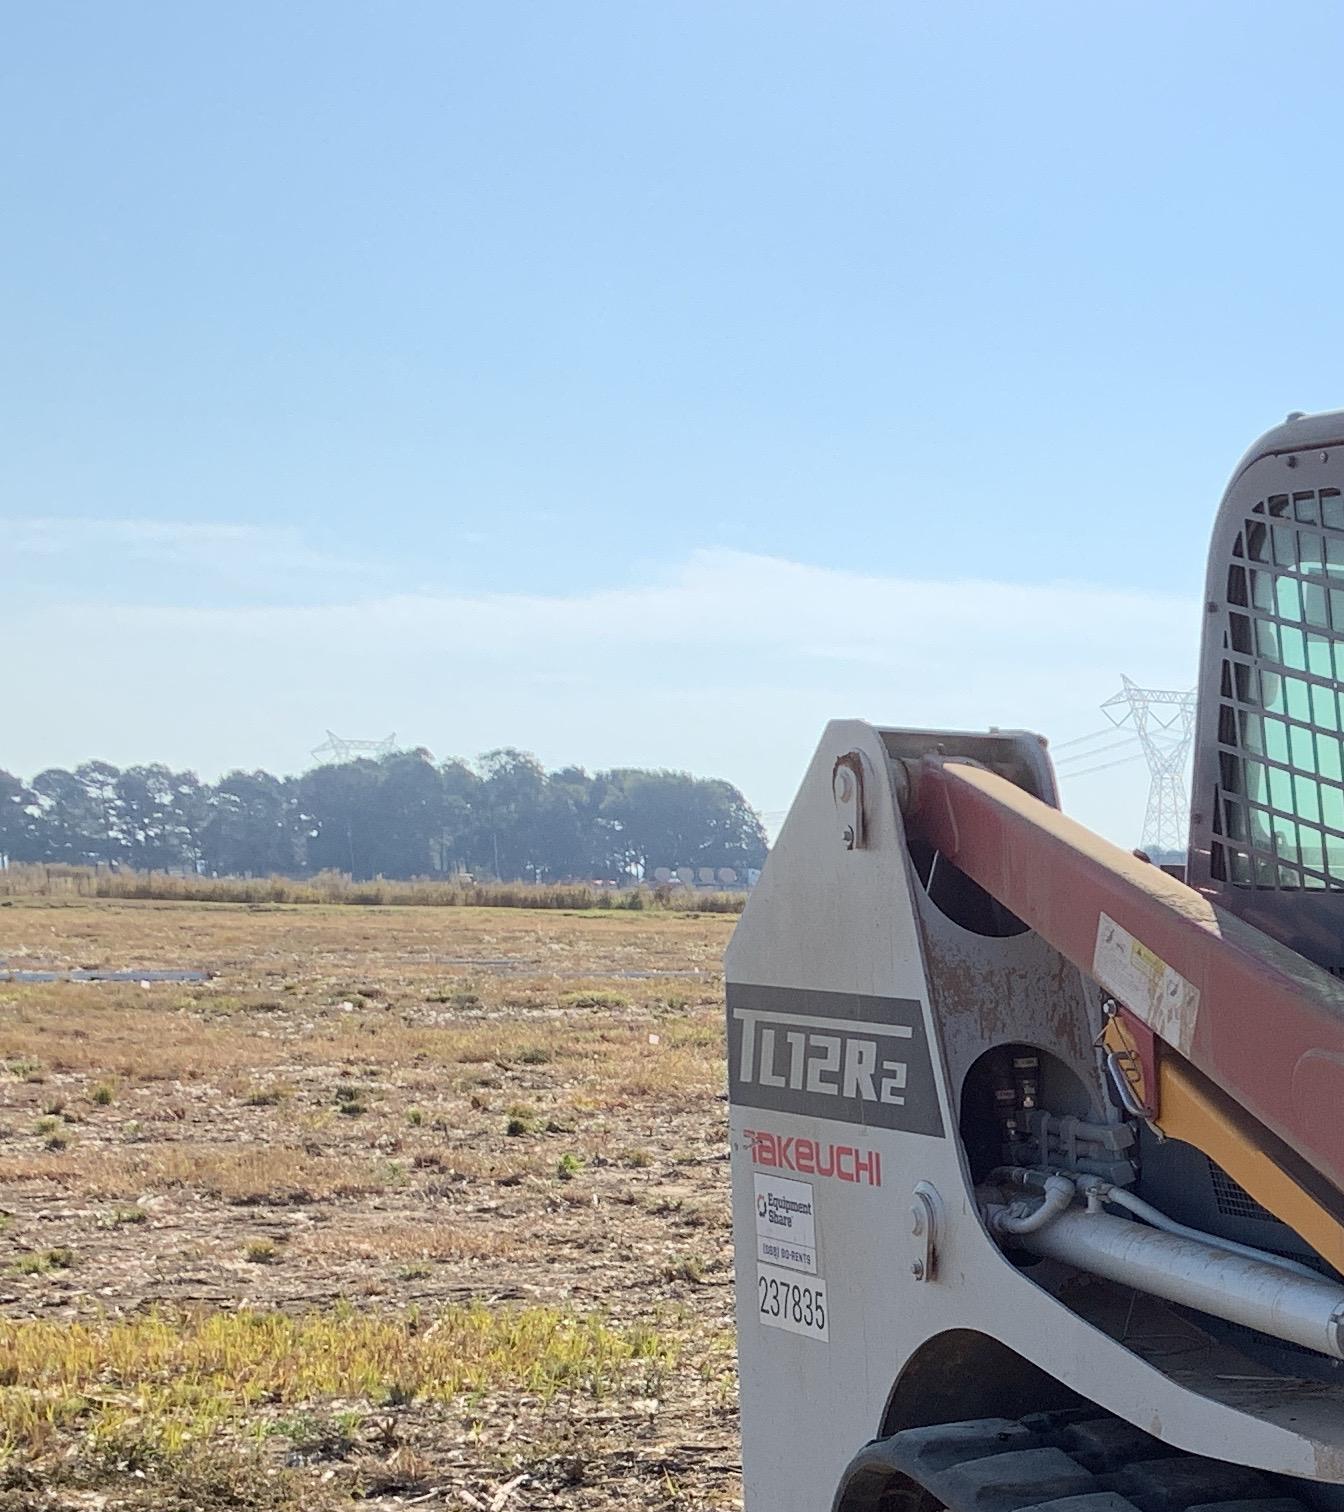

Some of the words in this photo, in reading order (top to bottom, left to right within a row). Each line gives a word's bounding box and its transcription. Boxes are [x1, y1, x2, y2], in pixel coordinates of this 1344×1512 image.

[732, 1007, 913, 1106] TL12R2
[767, 1192, 812, 1216] Equipment
[768, 1209, 793, 1228] Share
[758, 1275, 826, 1331] 237835
